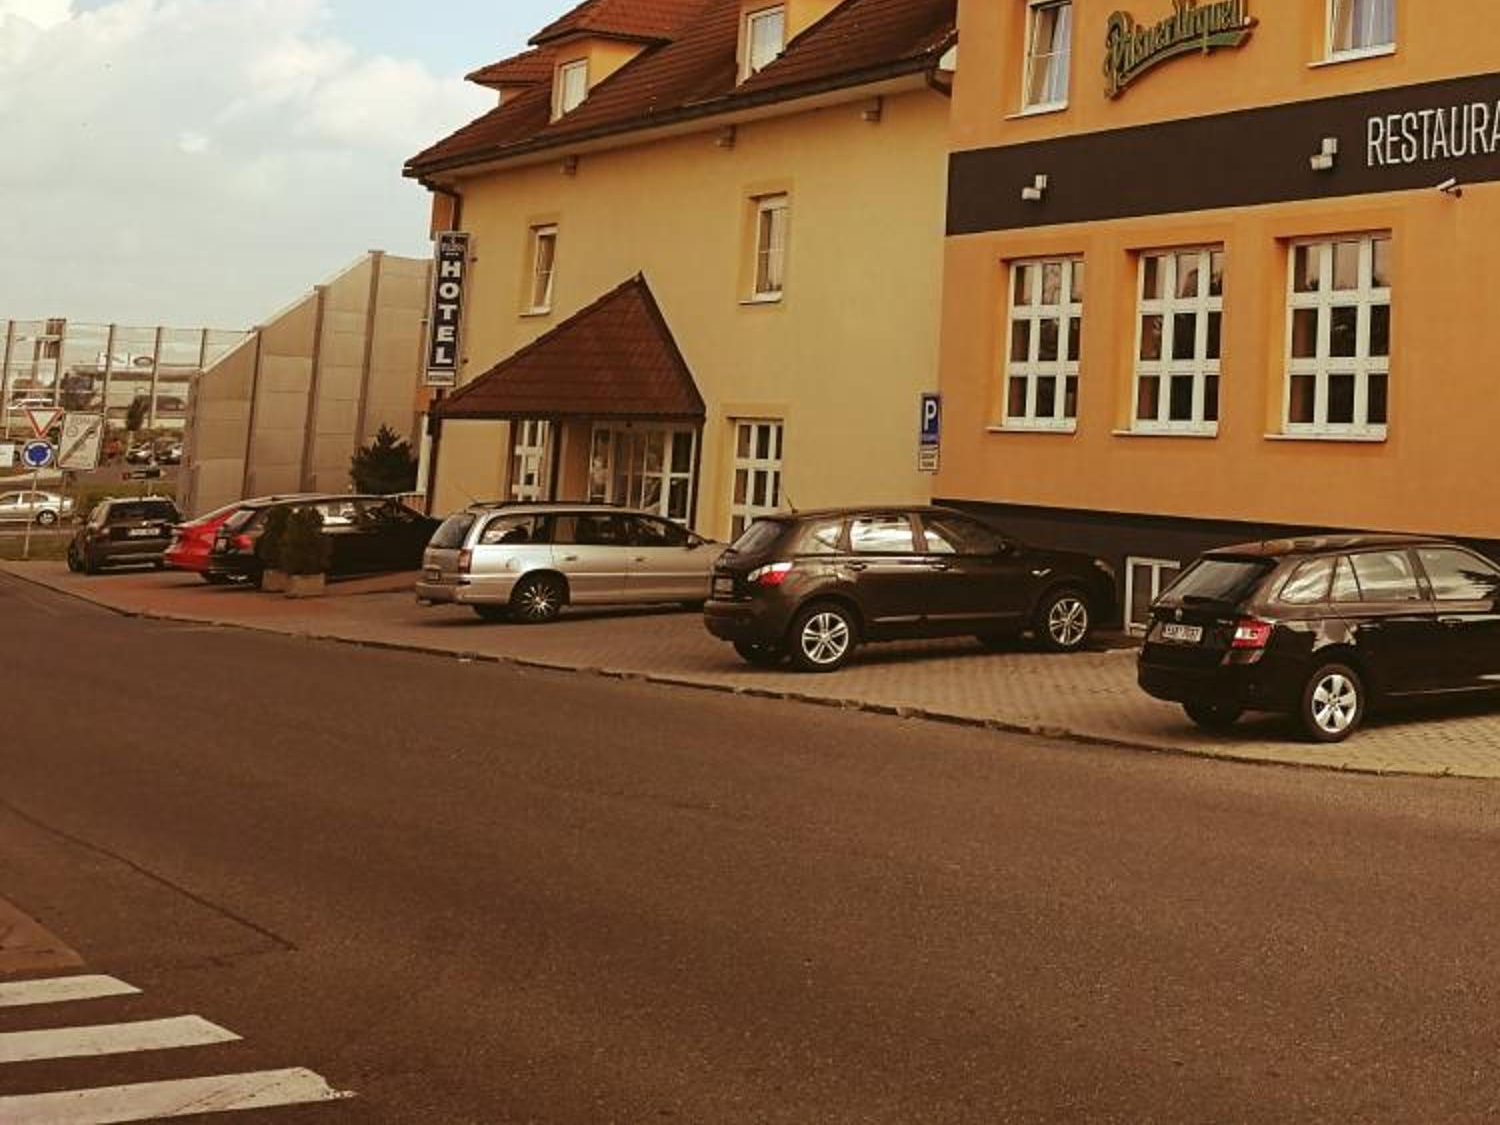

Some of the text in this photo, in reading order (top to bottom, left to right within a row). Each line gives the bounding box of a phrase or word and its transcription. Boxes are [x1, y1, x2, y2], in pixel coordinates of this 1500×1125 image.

[1104, 10, 1177, 99] Pilsner
[435, 260, 461, 364] HOTEL
[924, 399, 937, 431] P
